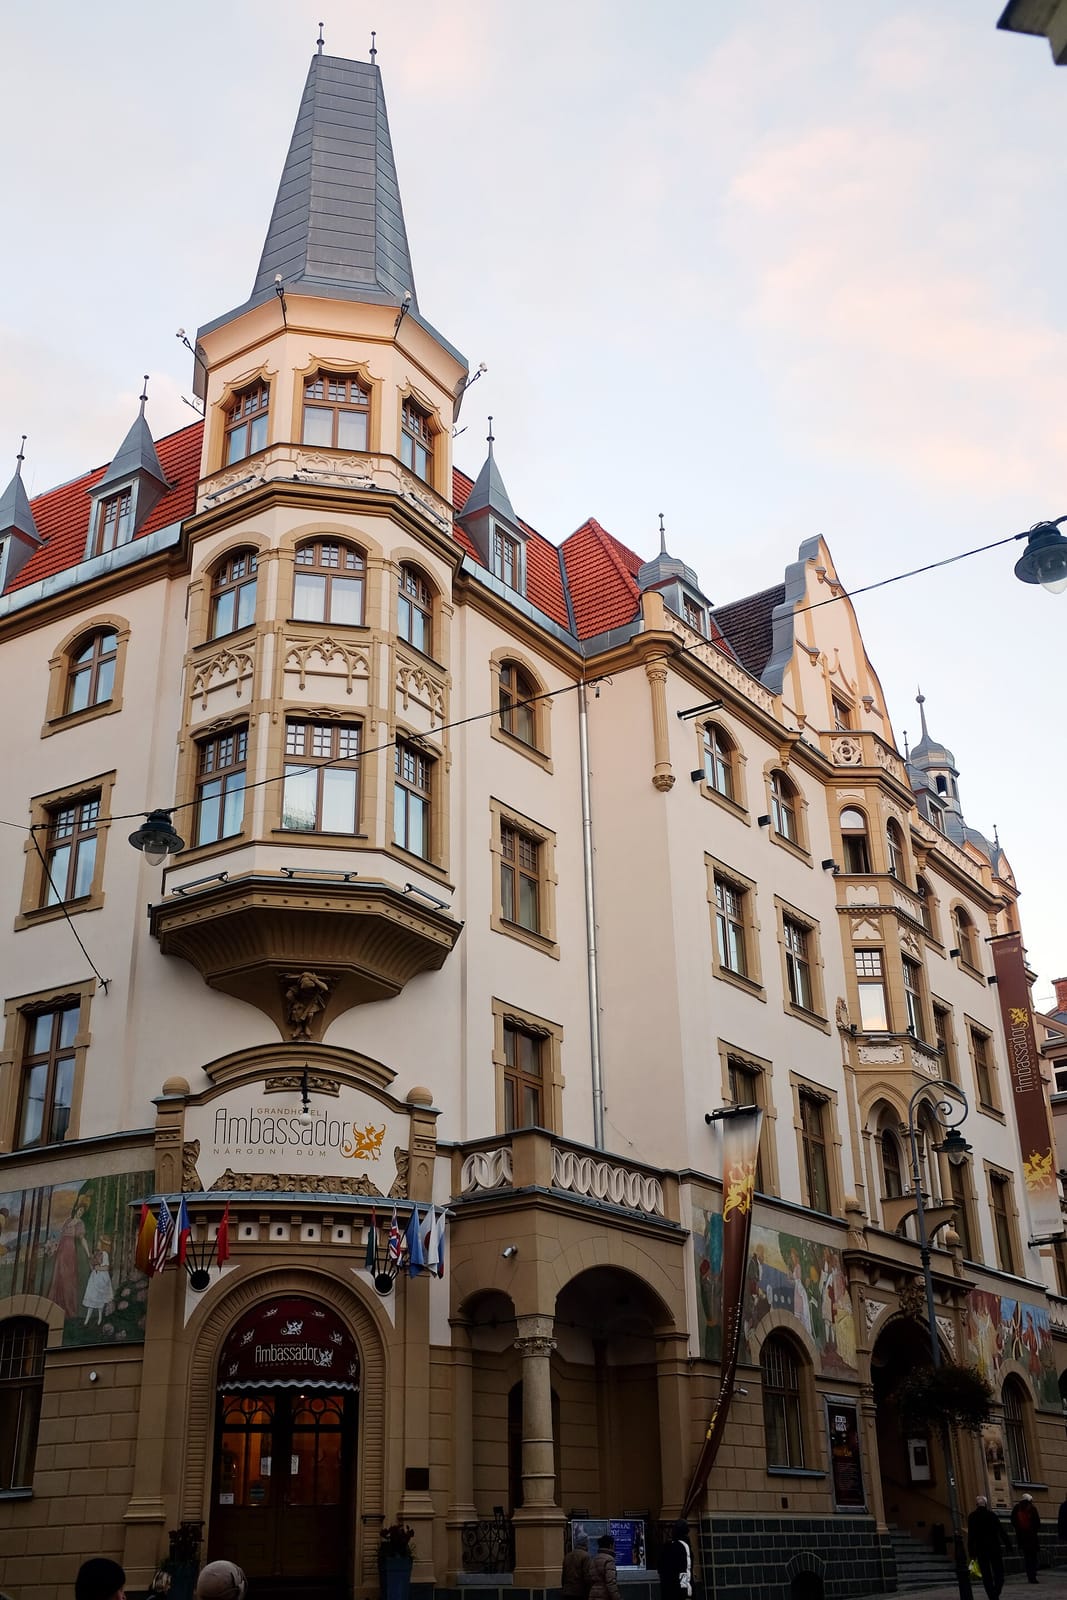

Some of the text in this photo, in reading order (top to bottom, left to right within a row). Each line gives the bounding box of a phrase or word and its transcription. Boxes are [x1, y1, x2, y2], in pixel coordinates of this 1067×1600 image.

[1009, 1025, 1033, 1092] Ambassador
[257, 1107, 321, 1117] GRANDHOEL
[214, 1108, 351, 1147] Ambassador
[213, 1148, 284, 1156] NÁRODNÍ
[255, 1343, 318, 1363] Ambassador
